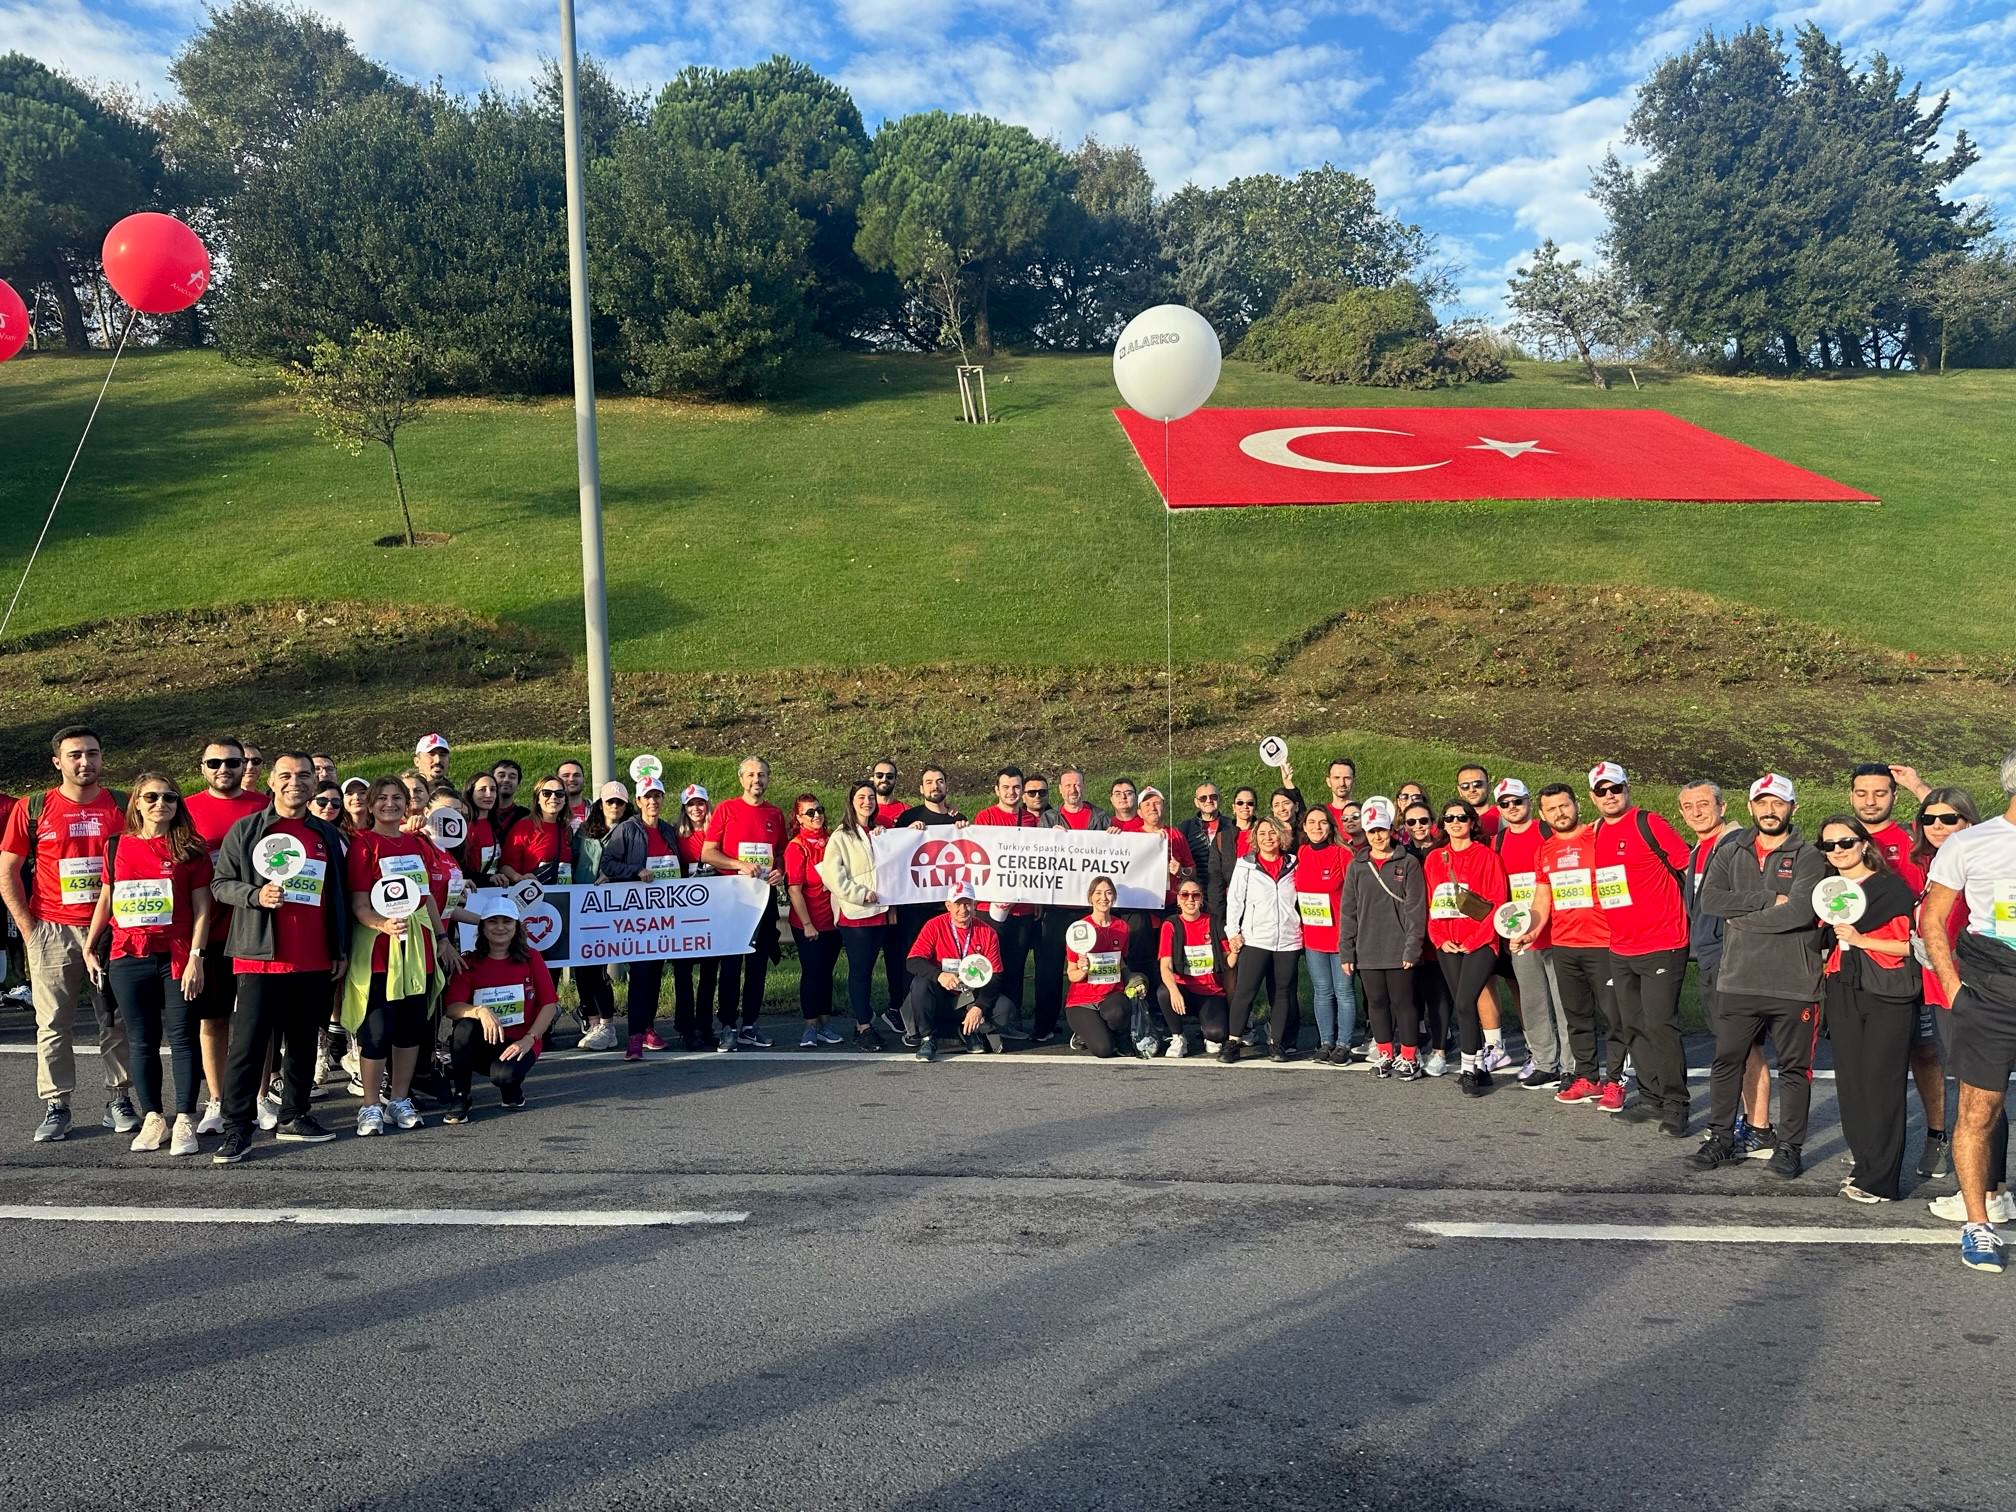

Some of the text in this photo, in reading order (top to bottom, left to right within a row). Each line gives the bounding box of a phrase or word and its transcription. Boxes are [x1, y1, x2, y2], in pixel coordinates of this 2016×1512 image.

[1127, 332, 1180, 355] ALARKO
[1068, 845, 1107, 854] Çocuklar
[997, 854, 1130, 875] CEREBRAL PALSY
[653, 871, 676, 879] 3632
[996, 870, 1064, 890] TÜRKİYE
[282, 877, 317, 891] 3656
[1556, 887, 1585, 898] 43683
[580, 883, 710, 914] ALARKO
[1515, 889, 1534, 899] 436
[120, 900, 164, 913] 43659
[612, 915, 675, 935] YAŞAM
[581, 931, 712, 960] GÖNÜLLÜLERİ
